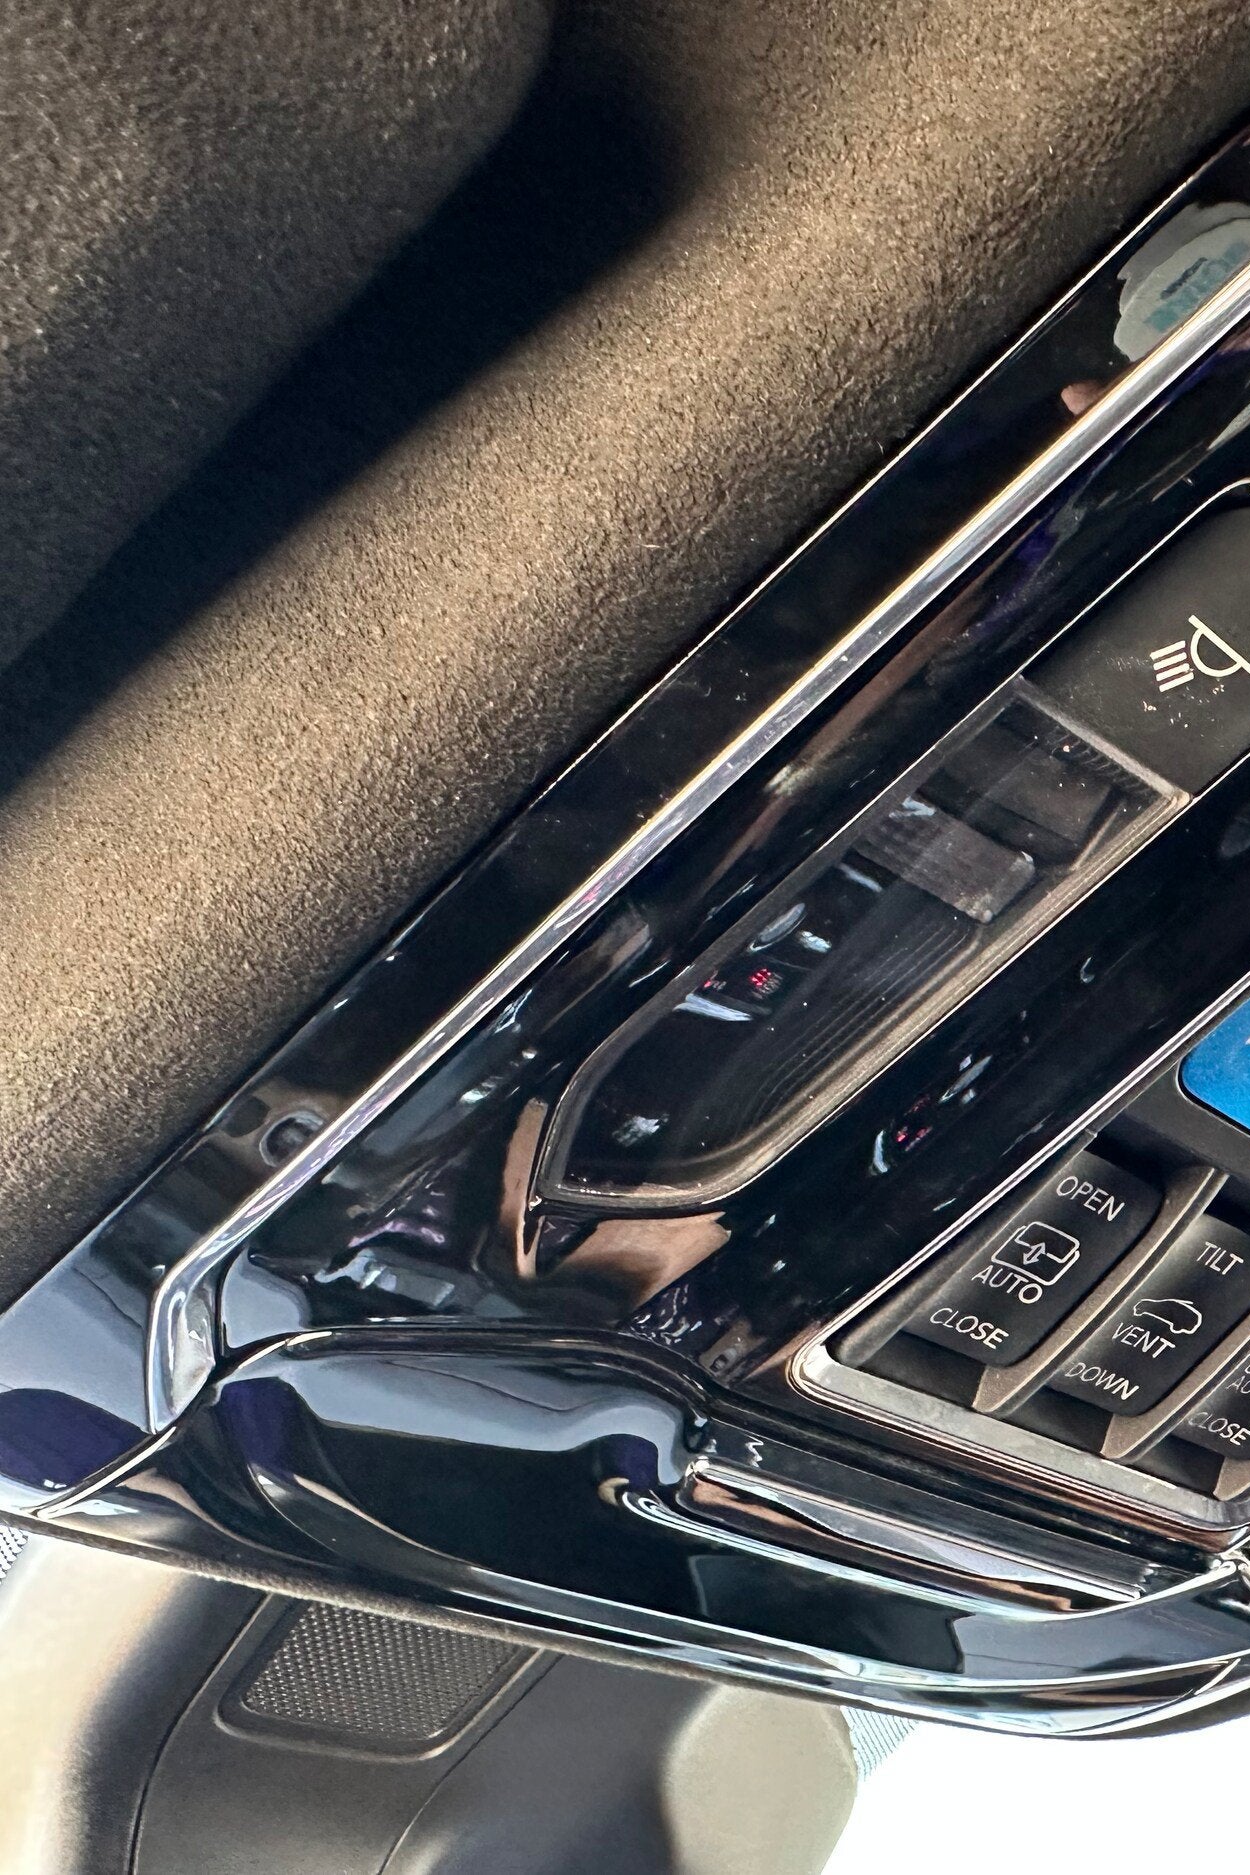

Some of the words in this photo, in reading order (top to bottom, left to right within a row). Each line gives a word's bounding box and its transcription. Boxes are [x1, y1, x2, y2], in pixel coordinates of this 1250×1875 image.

[1055, 1175, 1125, 1222] OPEN
[1196, 1241, 1244, 1276] TILT
[971, 1265, 1044, 1305] AUTO
[929, 1307, 1009, 1350] CLOSE
[1111, 1322, 1176, 1359] VENT
[1065, 1361, 1140, 1400] DOWN
